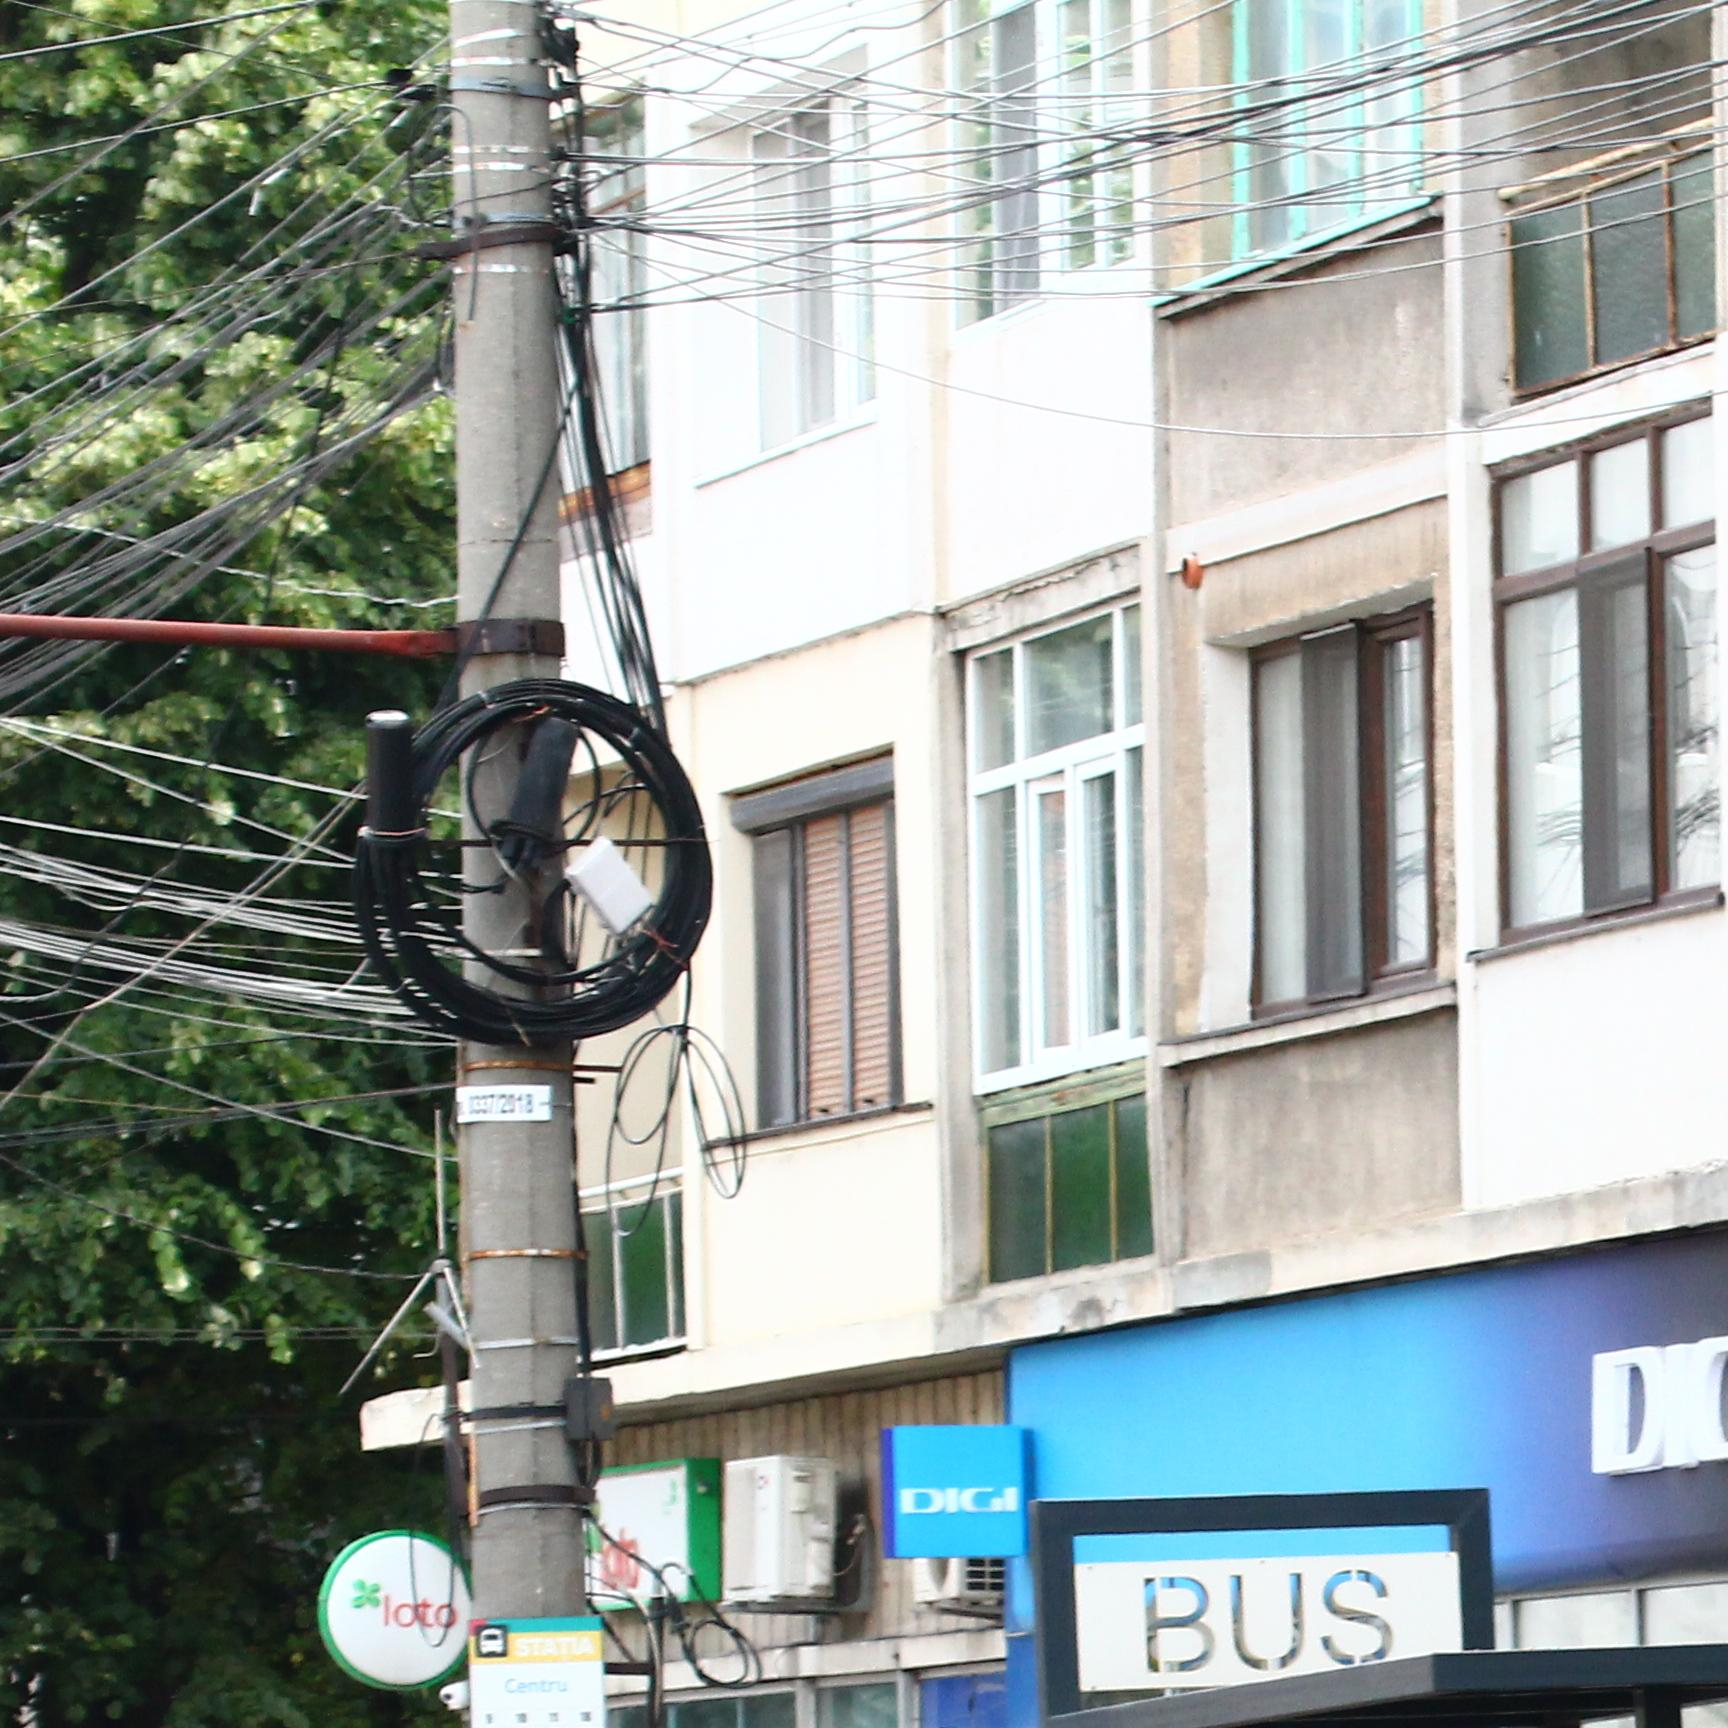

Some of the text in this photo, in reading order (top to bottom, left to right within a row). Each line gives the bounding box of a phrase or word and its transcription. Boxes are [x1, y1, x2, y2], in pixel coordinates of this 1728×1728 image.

[900, 1485, 1018, 1515] DIGI
[382, 1594, 460, 1629] loto
[1143, 1568, 1394, 1674] BUS
[504, 1678, 568, 1694] Centru
